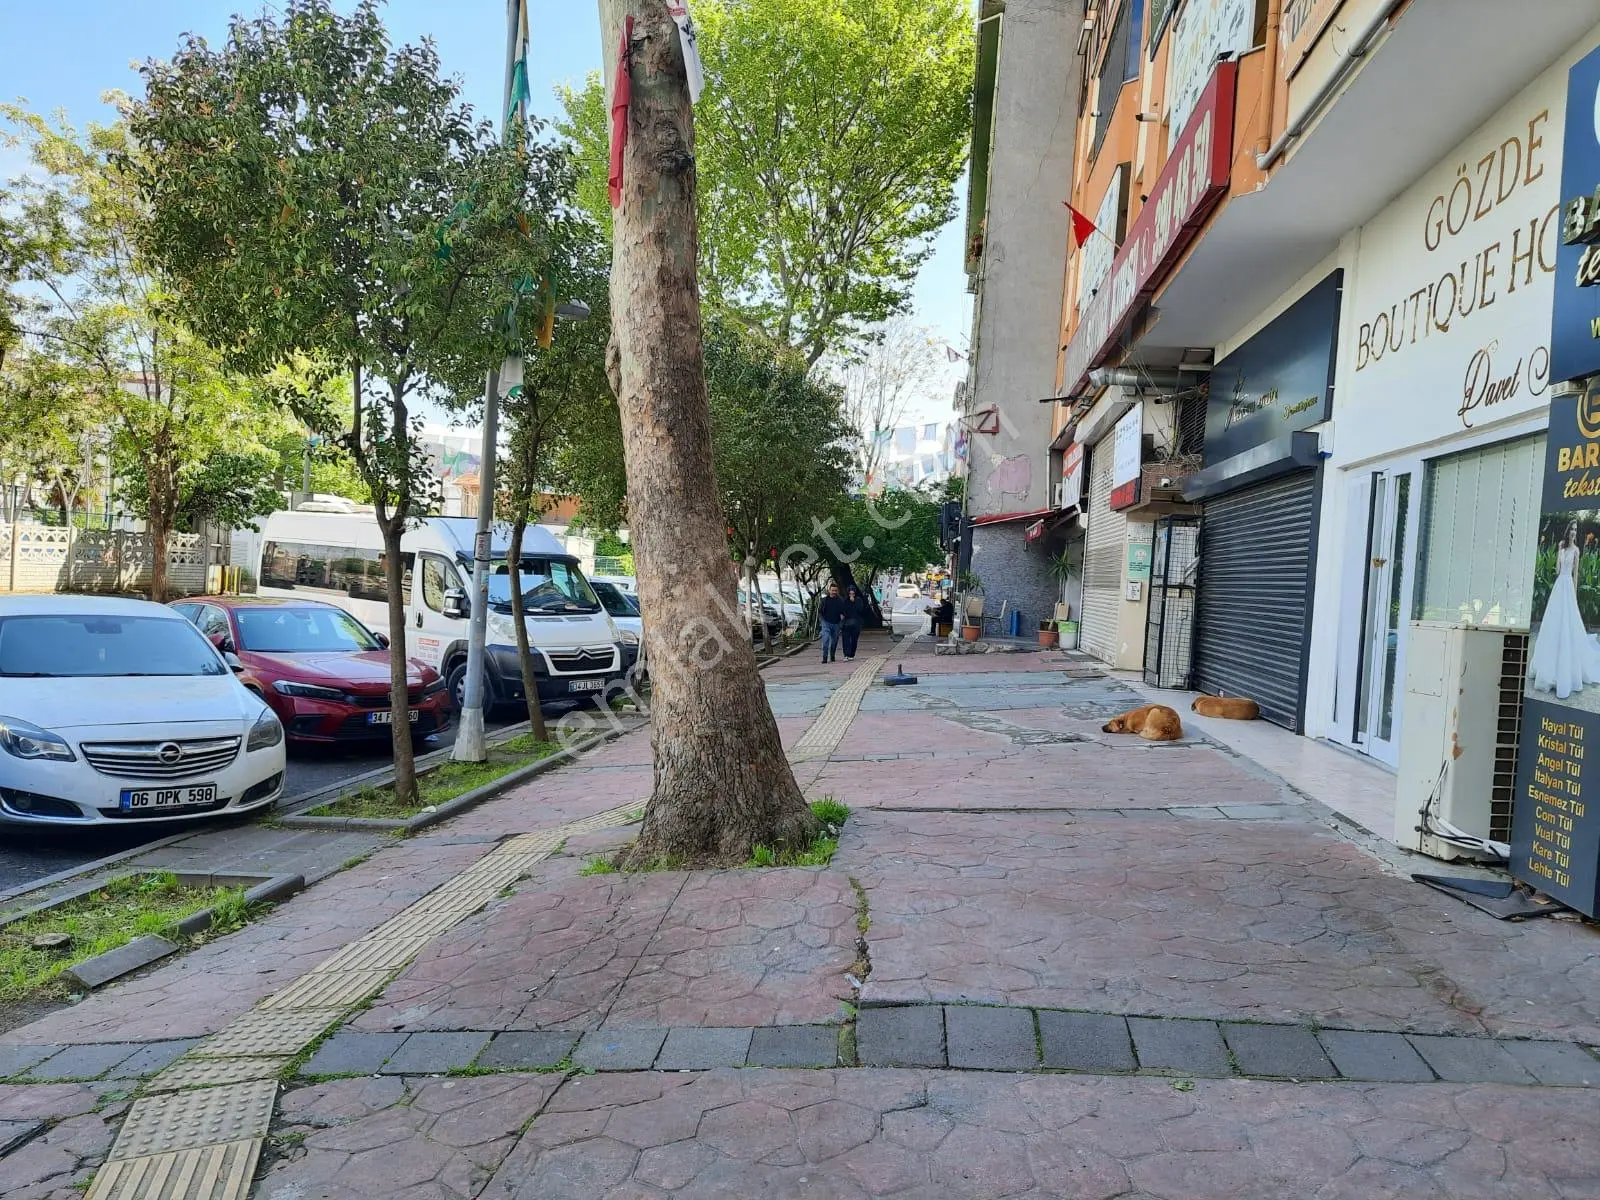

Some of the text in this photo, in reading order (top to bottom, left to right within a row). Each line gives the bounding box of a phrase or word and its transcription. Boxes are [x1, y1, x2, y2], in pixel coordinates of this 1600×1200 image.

[1191, 109, 1212, 205] 50
[1425, 109, 1549, 251] GÖZDE
[1356, 242, 1500, 372] BOUTIQUE
[1457, 339, 1522, 428] Davet
[373, 713, 383, 722] 34
[1541, 717, 1584, 740] Hayal Tül
[1538, 734, 1584, 760] Kristal Tül
[1538, 752, 1581, 778] Angel Tül
[1535, 766, 1581, 797] İtalyan Tül
[131, 792, 149, 807] 06
[156, 790, 182, 805] DPK
[188, 788, 213, 802] 598
[1528, 785, 1585, 817] Esnemez Tül
[1535, 823, 1570, 850] Vual Tül
[1558, 815, 1573, 832] Tül
[1532, 840, 1569, 869] Kare Tül
[1528, 857, 1570, 888] Lehte Tül
